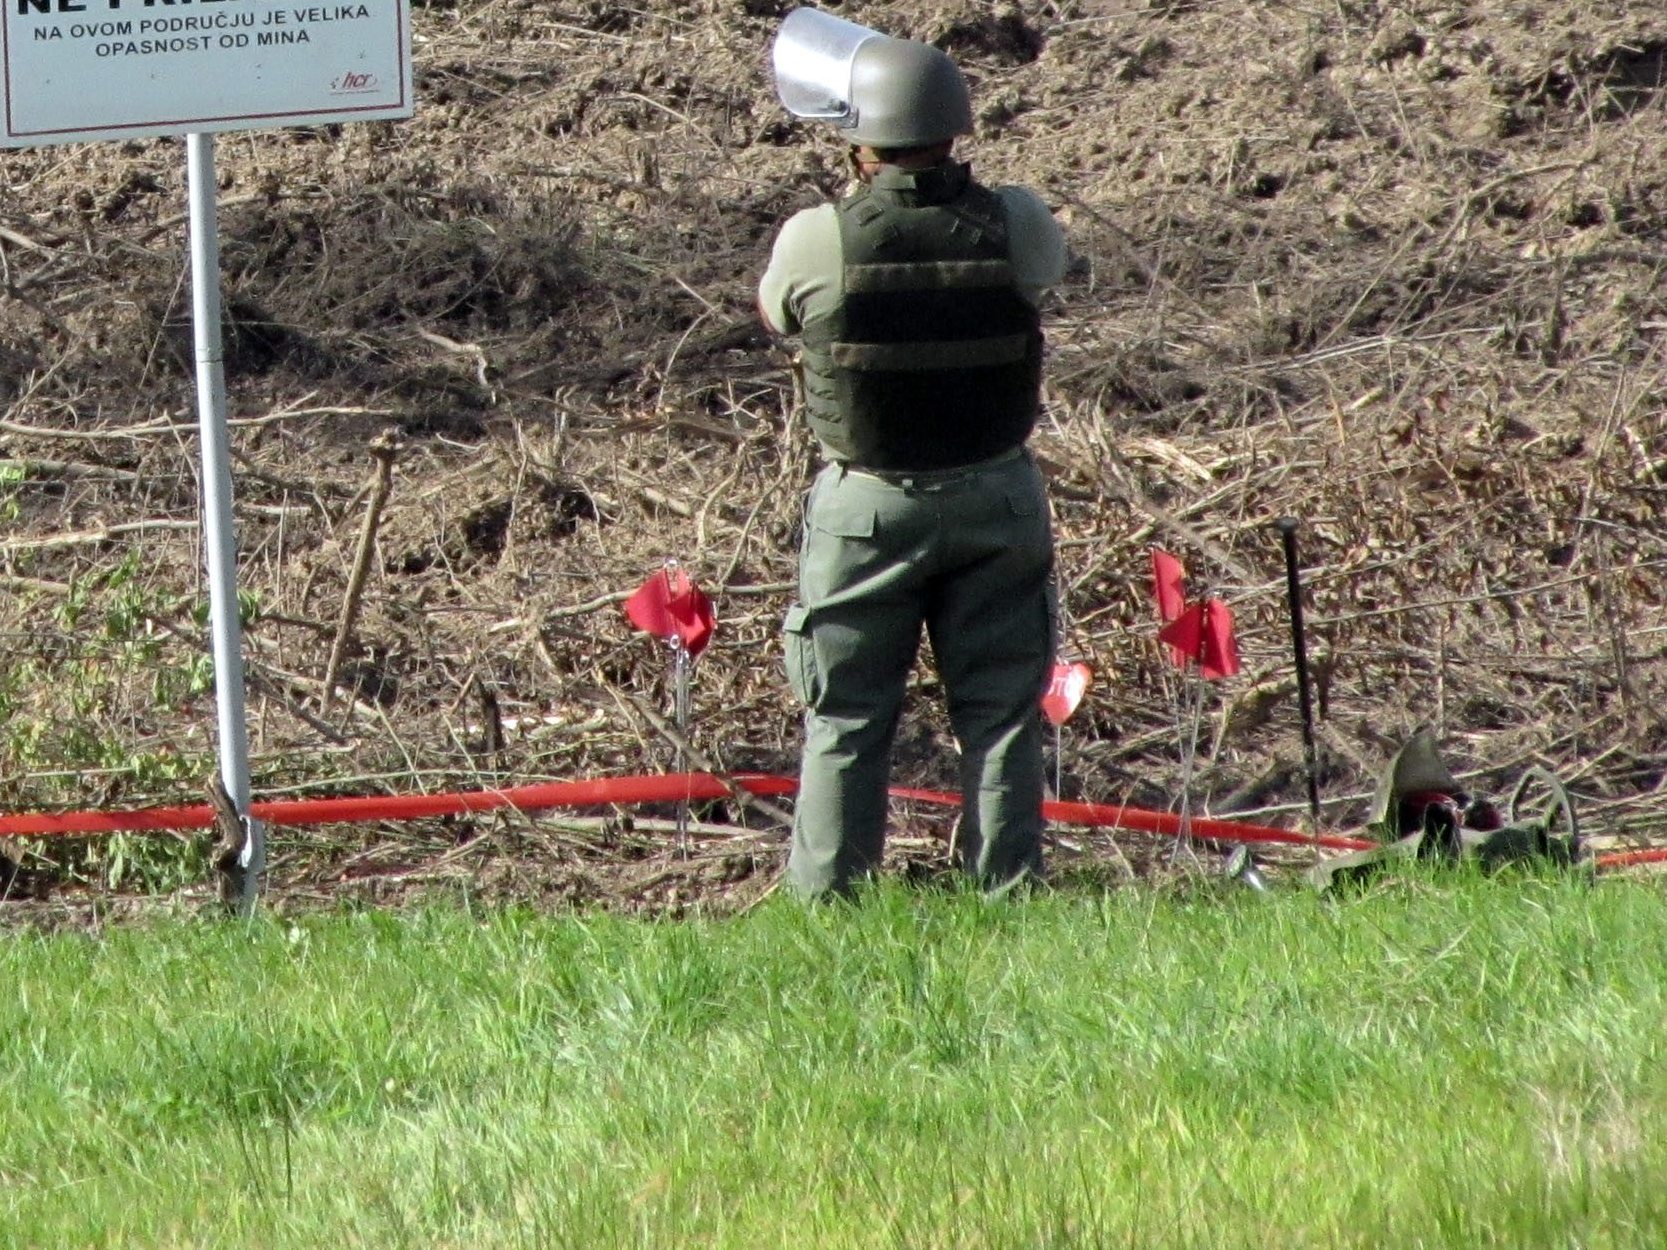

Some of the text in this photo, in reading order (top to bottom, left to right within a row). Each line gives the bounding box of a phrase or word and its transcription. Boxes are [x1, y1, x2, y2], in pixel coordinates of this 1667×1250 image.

[34, 4, 370, 41] NA OVOM PODRUČJU JE VELIKA
[95, 27, 310, 58] OPASNOST OD MINA
